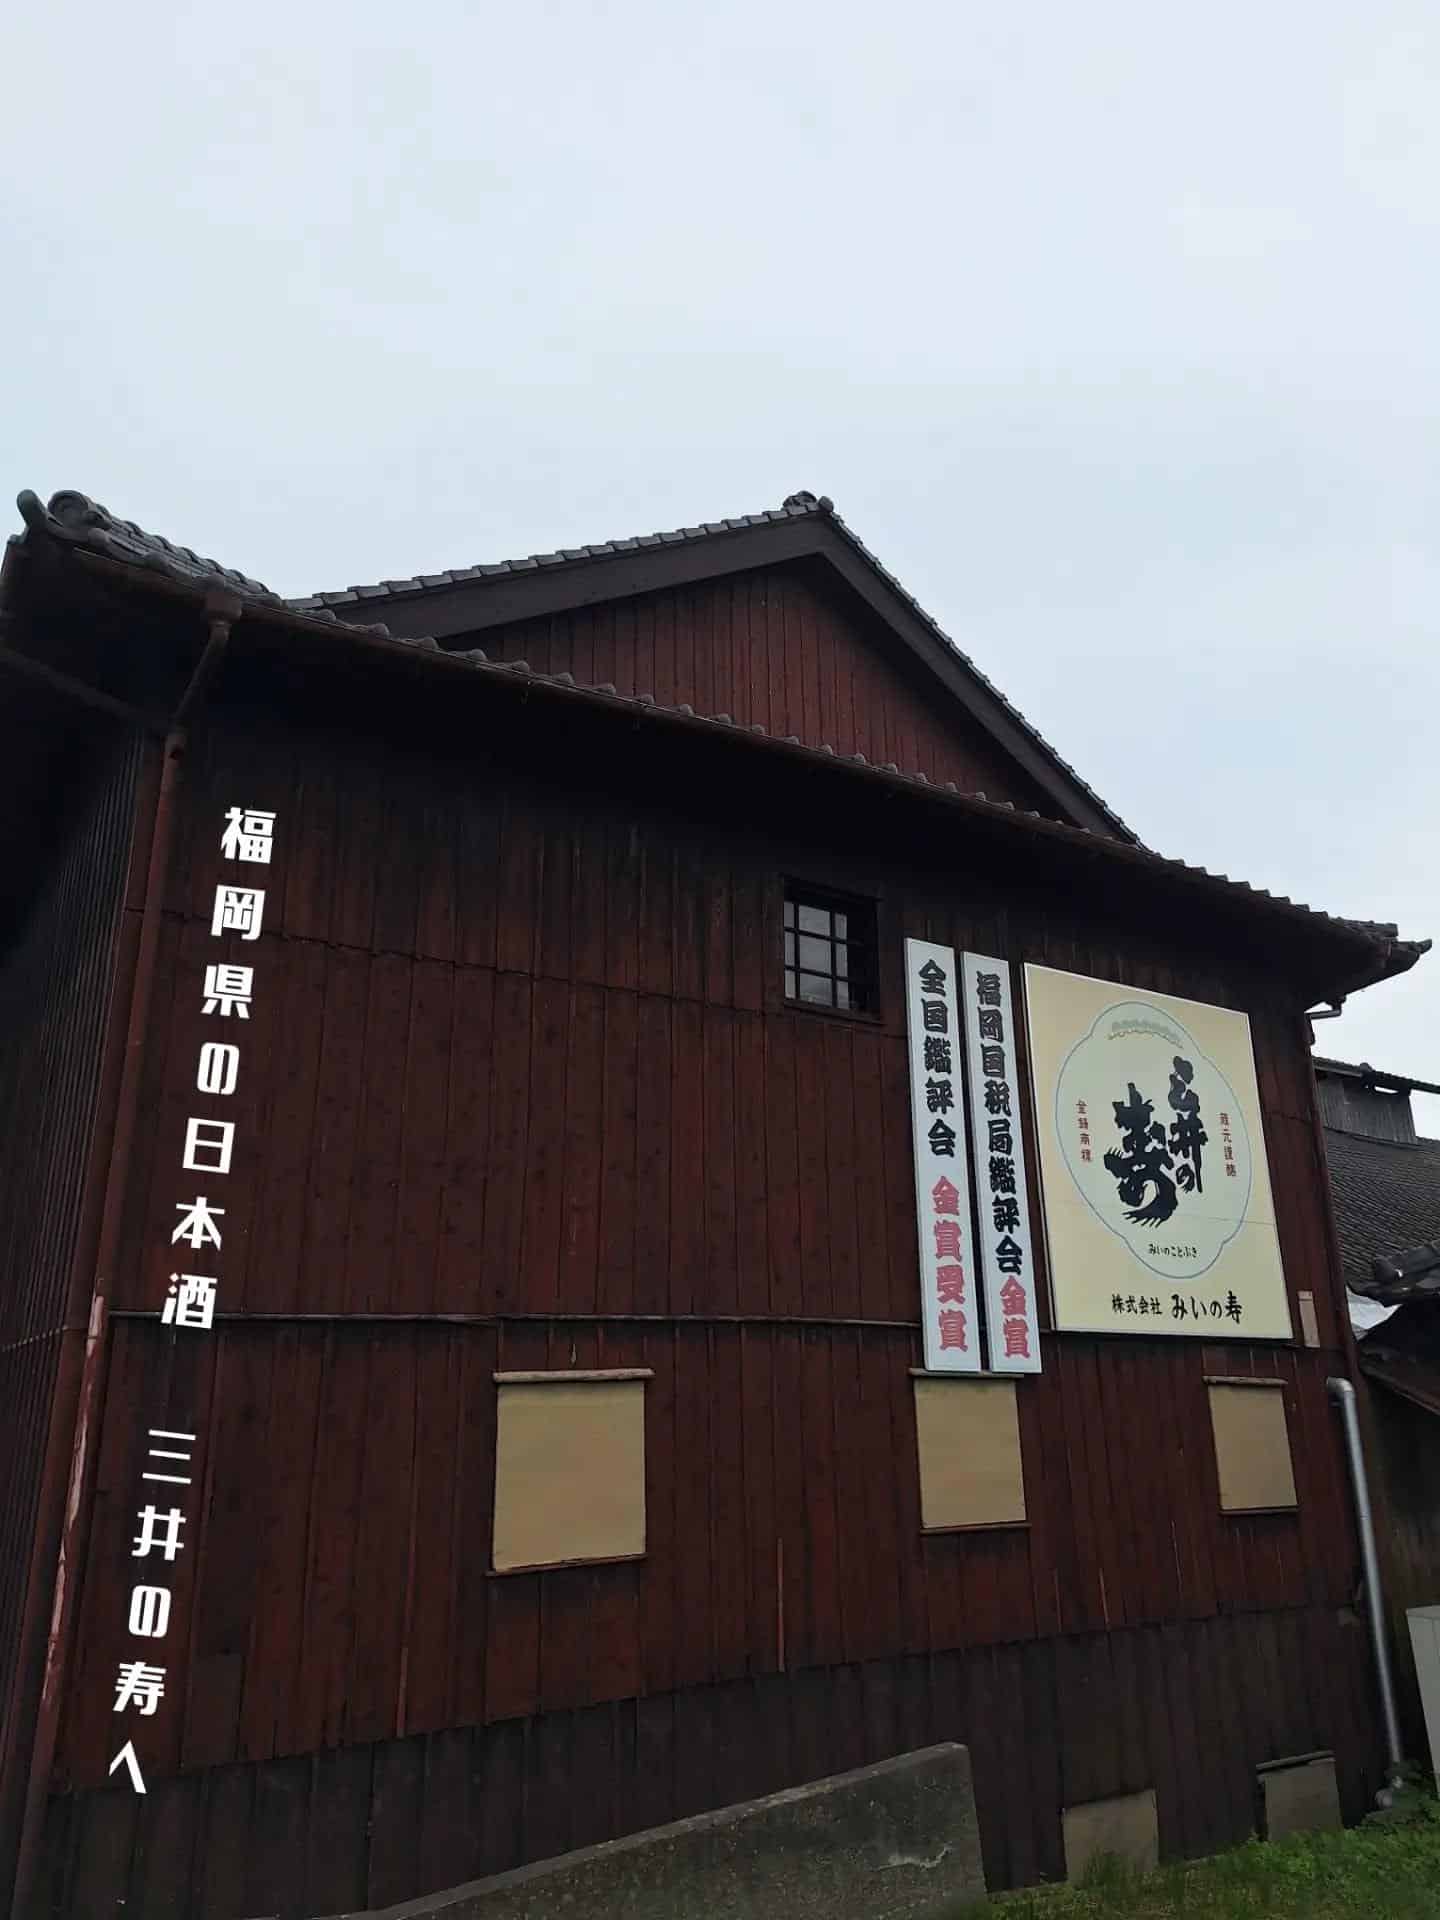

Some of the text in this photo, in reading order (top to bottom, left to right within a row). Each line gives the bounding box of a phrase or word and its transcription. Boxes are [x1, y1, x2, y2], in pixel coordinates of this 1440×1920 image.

[109, 806, 277, 1794] 福岡県の日本酒 三井の寿へ
[918, 959, 968, 1352] 全国鑑評会 金賞受賞
[1111, 1290, 1243, 1324] 株式会社 みいの寿
